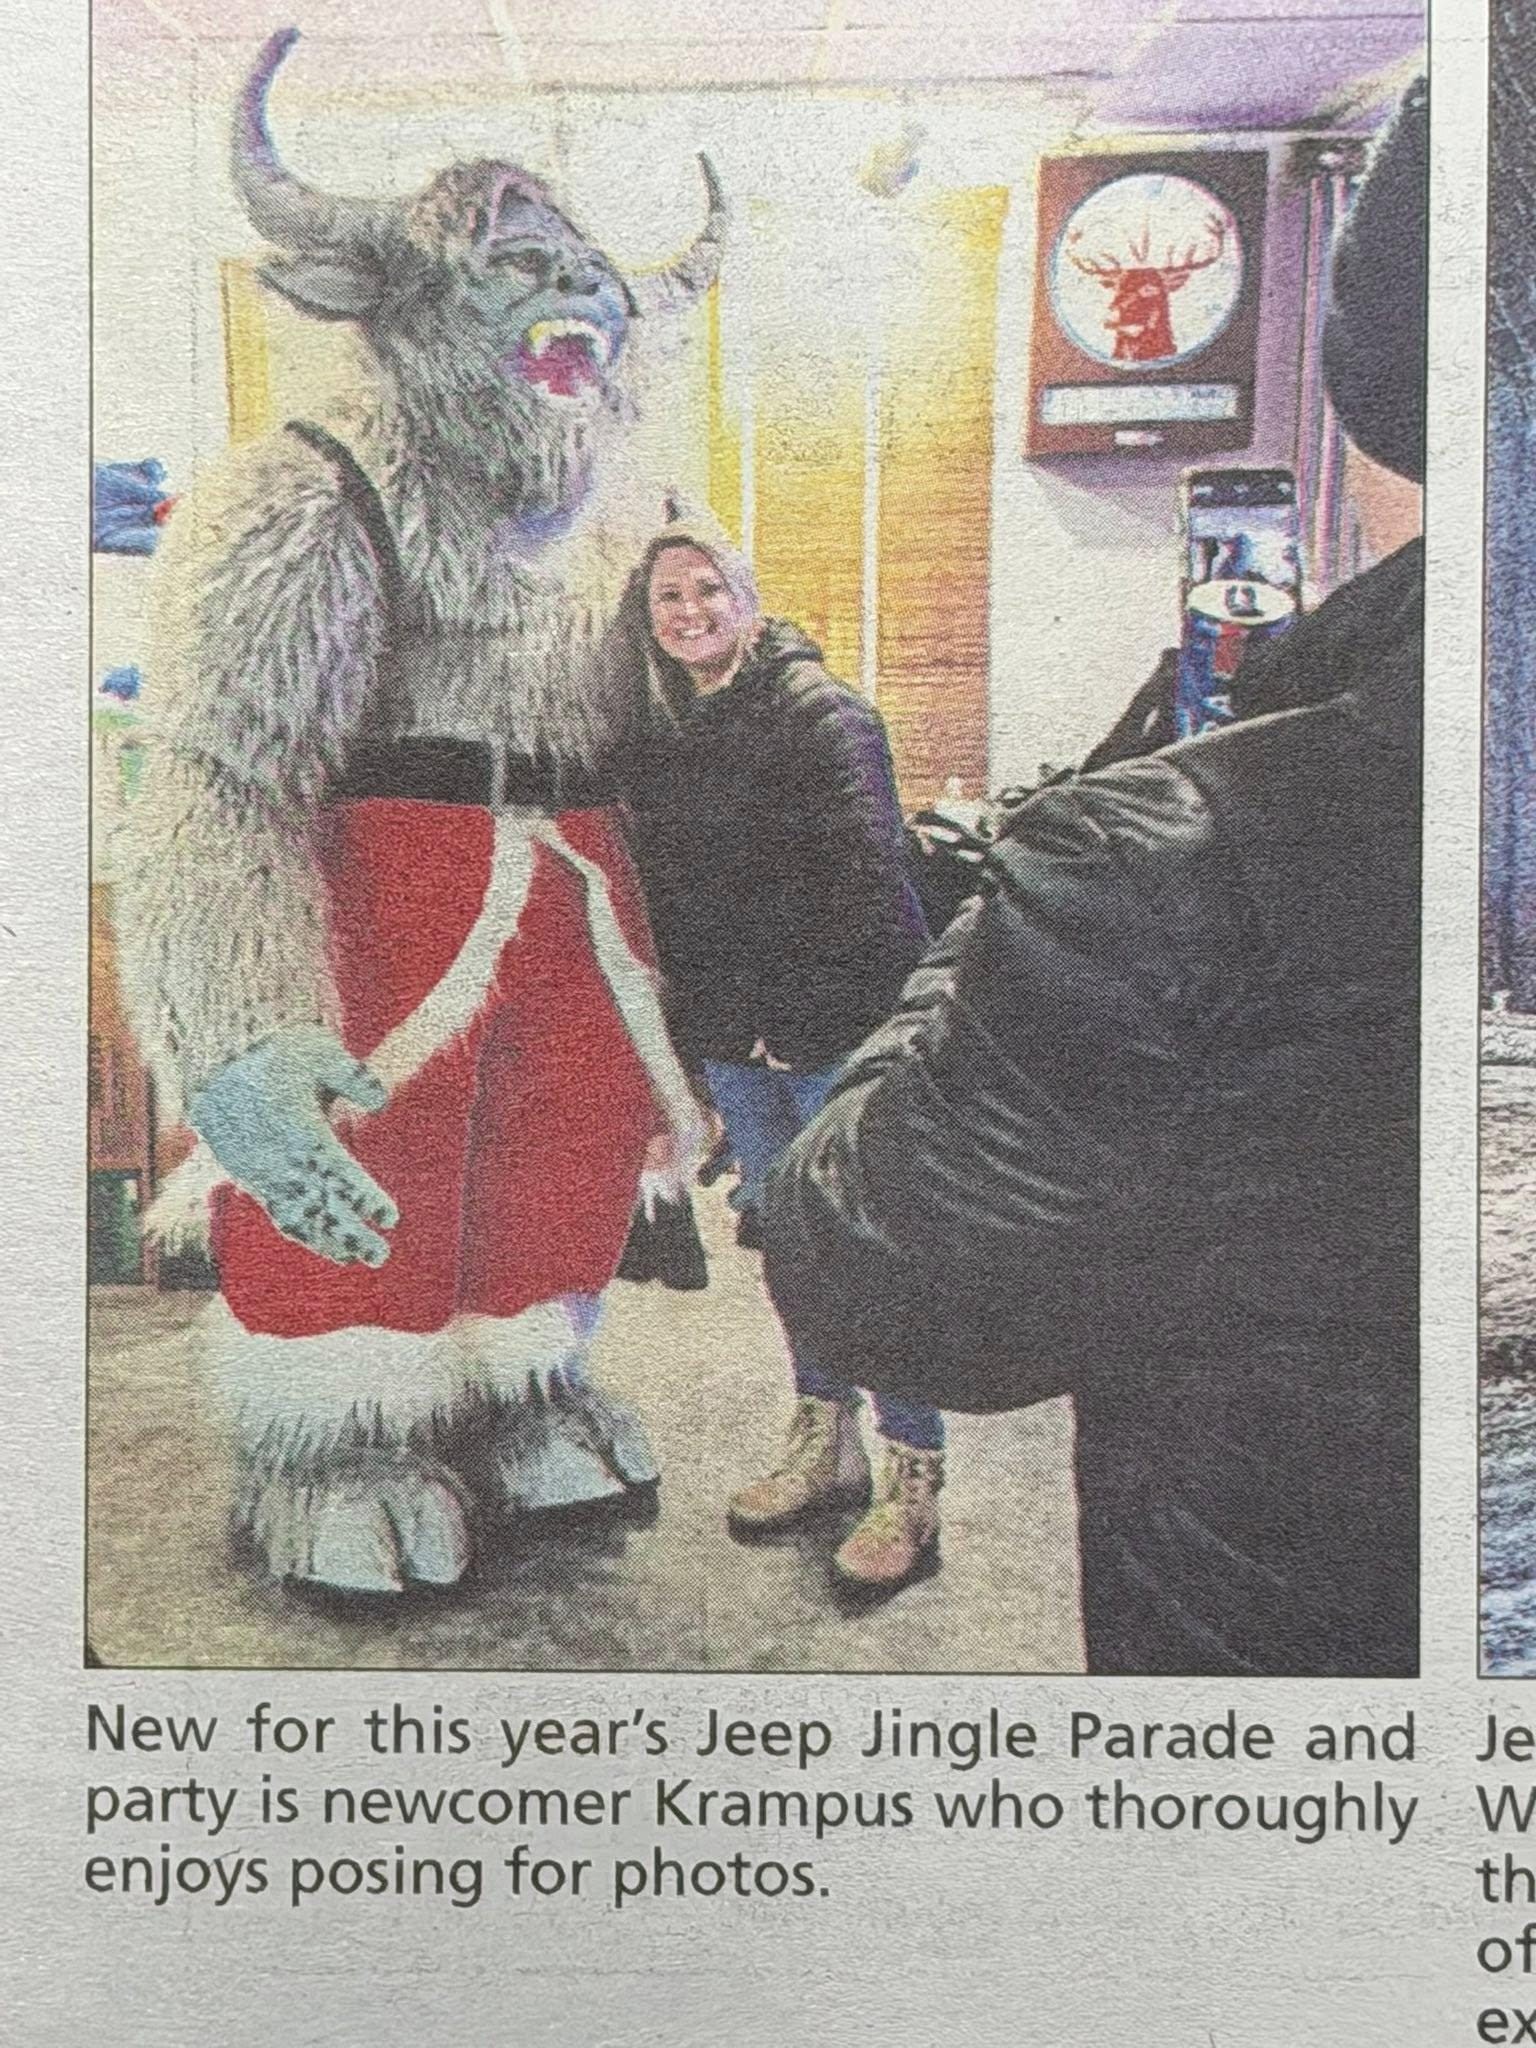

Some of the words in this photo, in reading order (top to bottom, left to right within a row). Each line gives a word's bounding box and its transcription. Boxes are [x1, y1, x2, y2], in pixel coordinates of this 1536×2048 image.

[89, 1705, 217, 1752] New
[247, 1702, 335, 1754] for
[364, 1704, 470, 1754] this
[501, 1709, 667, 1769] year’s
[697, 1709, 831, 1770] Jeep
[862, 1708, 1036, 1771] Jingle
[1072, 1710, 1274, 1761] Parade
[1306, 1711, 1414, 1762] and
[88, 1778, 237, 1836] party
[263, 1774, 298, 1824] is
[325, 1789, 631, 1826] newcomer
[658, 1779, 912, 1840] Krampus
[935, 1778, 1063, 1829] who
[1086, 1780, 1418, 1845] thoroughly
[86, 1844, 267, 1906] enjoys
[292, 1846, 481, 1908] posing
[505, 1845, 591, 1896] for
[616, 1847, 829, 1909] photos.
[1475, 1853, 1536, 1903] th
[1478, 1923, 1536, 1973] of
[1478, 2009, 1536, 2044] ex
